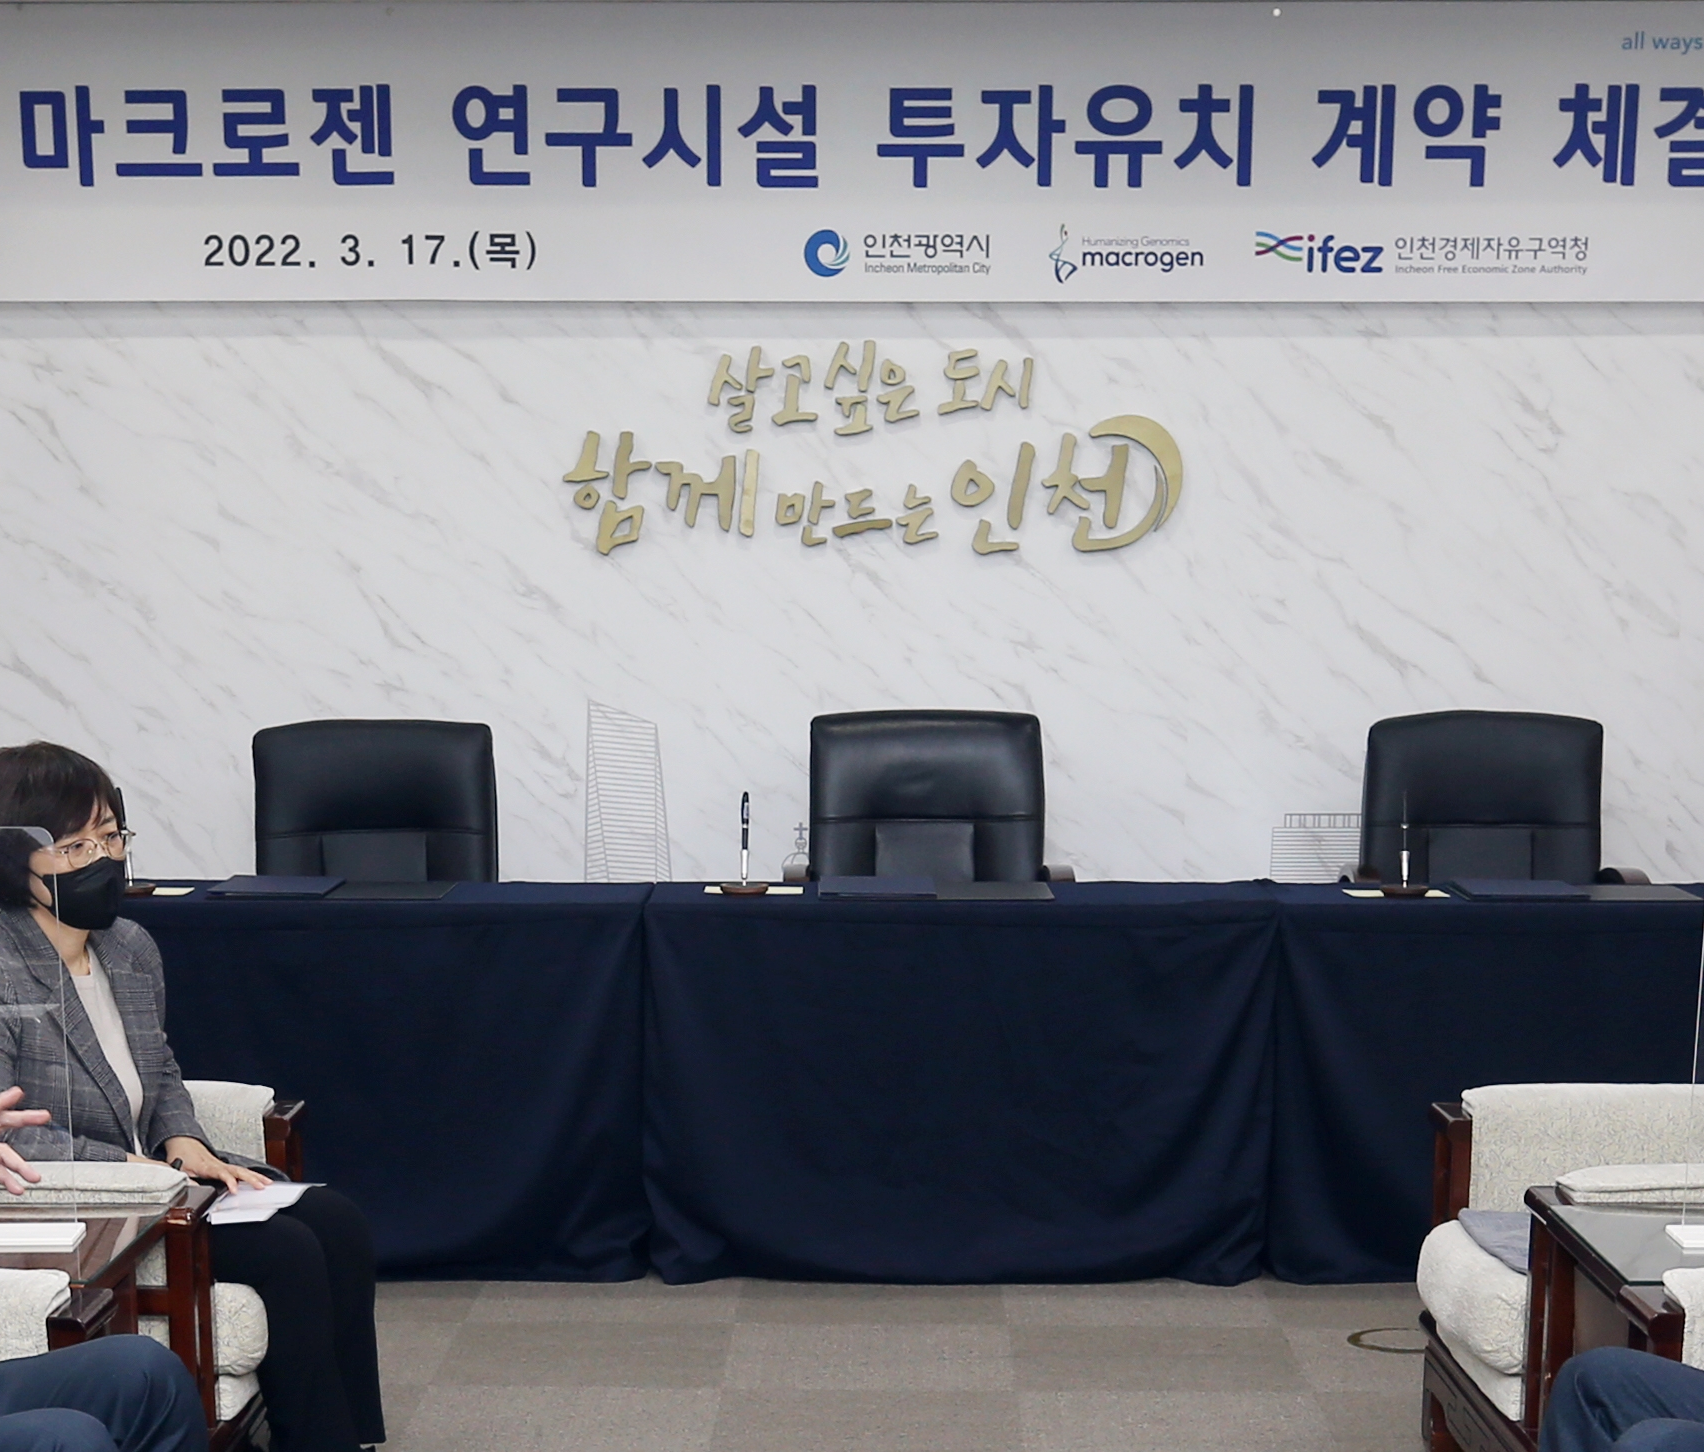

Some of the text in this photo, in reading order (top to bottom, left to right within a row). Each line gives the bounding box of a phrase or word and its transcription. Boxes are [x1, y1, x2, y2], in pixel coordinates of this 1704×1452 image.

[1621, 30, 1645, 50] all
[1652, 37, 1703, 55] ways
[19, 83, 395, 187] 마크로젠
[451, 83, 819, 188] 연구시설
[875, 83, 1255, 188] 투자유치
[1311, 83, 1502, 188] 계약
[203, 230, 537, 271] 2022. 3. 17.(목)
[863, 233, 990, 260] 인천광역시
[1081, 235, 1190, 248] Humanizing Genomics
[1306, 234, 1385, 274] ifez
[1394, 235, 1589, 262] 인천경제자유구역청
[864, 261, 991, 276] Incheon Metropolitan City
[1081, 248, 1204, 274] macrogen
[1394, 264, 1588, 276] Incheon Free Economic Zone Authority
[936, 347, 1034, 416] 도시
[562, 416, 1183, 555] 함께 만드는 인천
